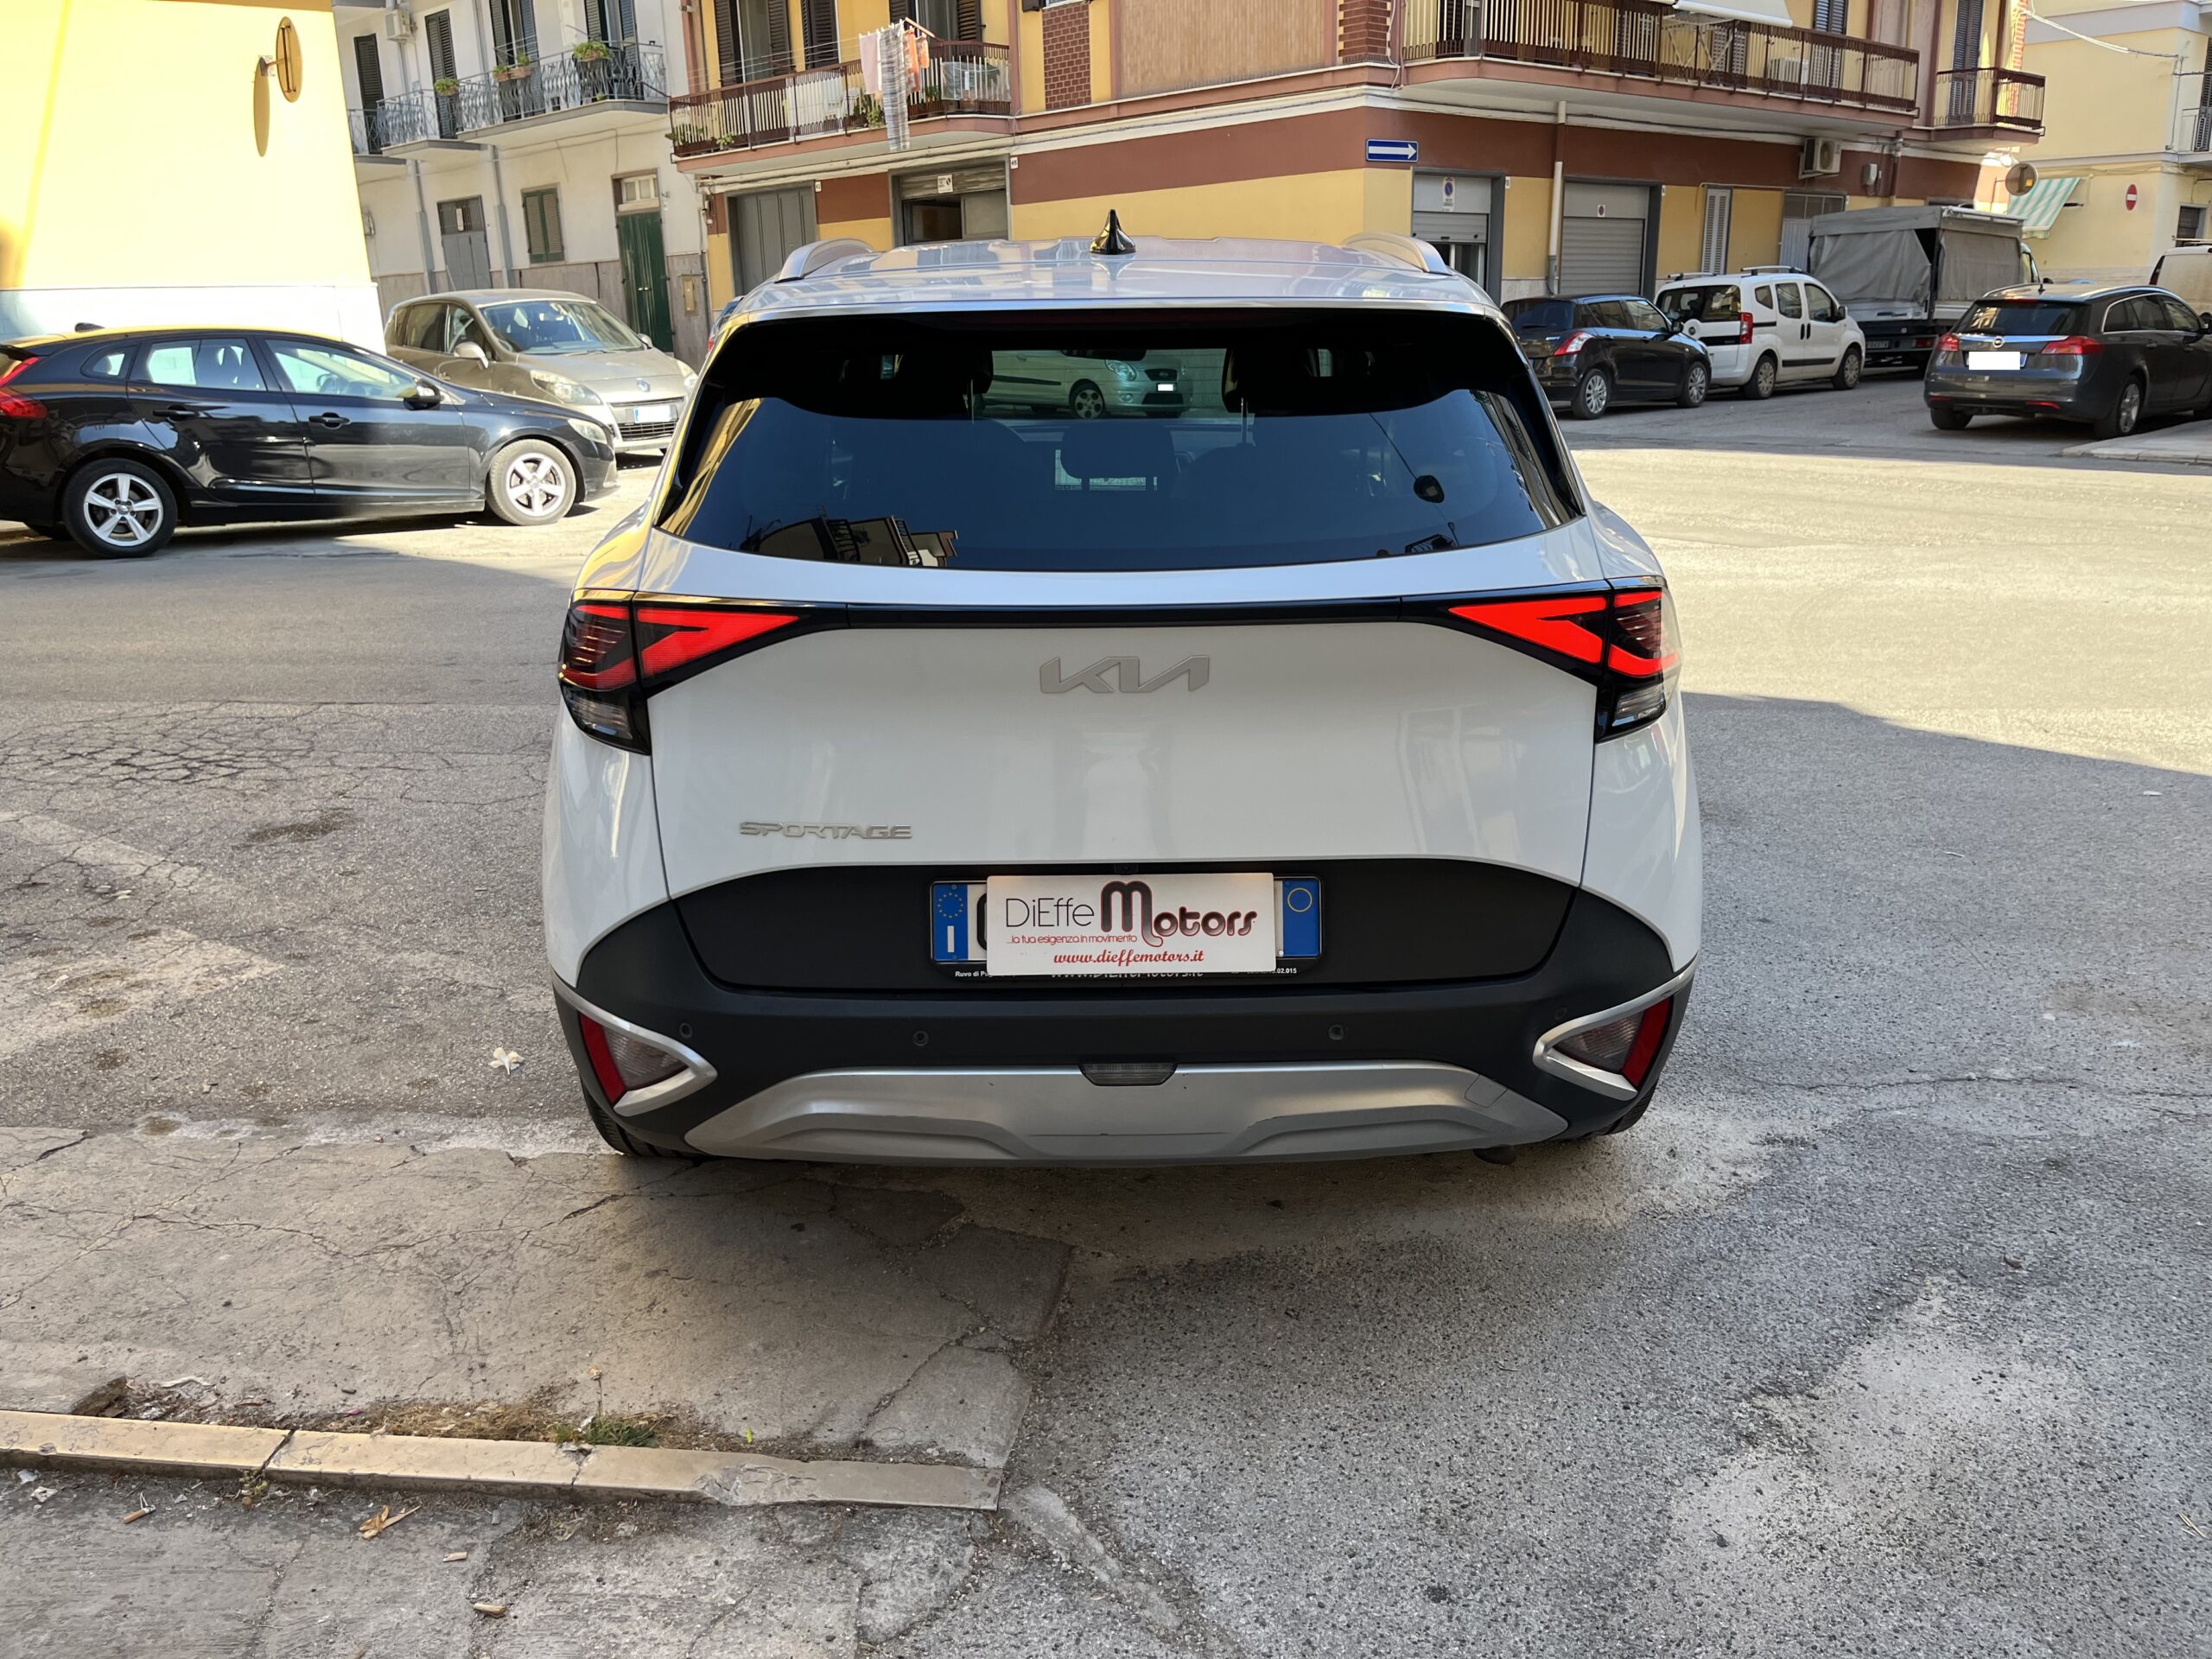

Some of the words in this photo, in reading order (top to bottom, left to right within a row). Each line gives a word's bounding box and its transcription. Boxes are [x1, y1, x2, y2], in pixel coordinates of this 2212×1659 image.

[1039, 655, 1210, 693] KIA
[740, 822, 912, 840] SPORTAGE
[1006, 897, 1095, 927] DiEffe
[1101, 880, 1258, 948] Motors
[1021, 935, 1036, 944] tua
[1037, 935, 1079, 946] esigenza
[1080, 934, 1087, 943] in
[1088, 934, 1138, 944] movimento
[1053, 950, 1205, 967] www.dieffemotors.it
